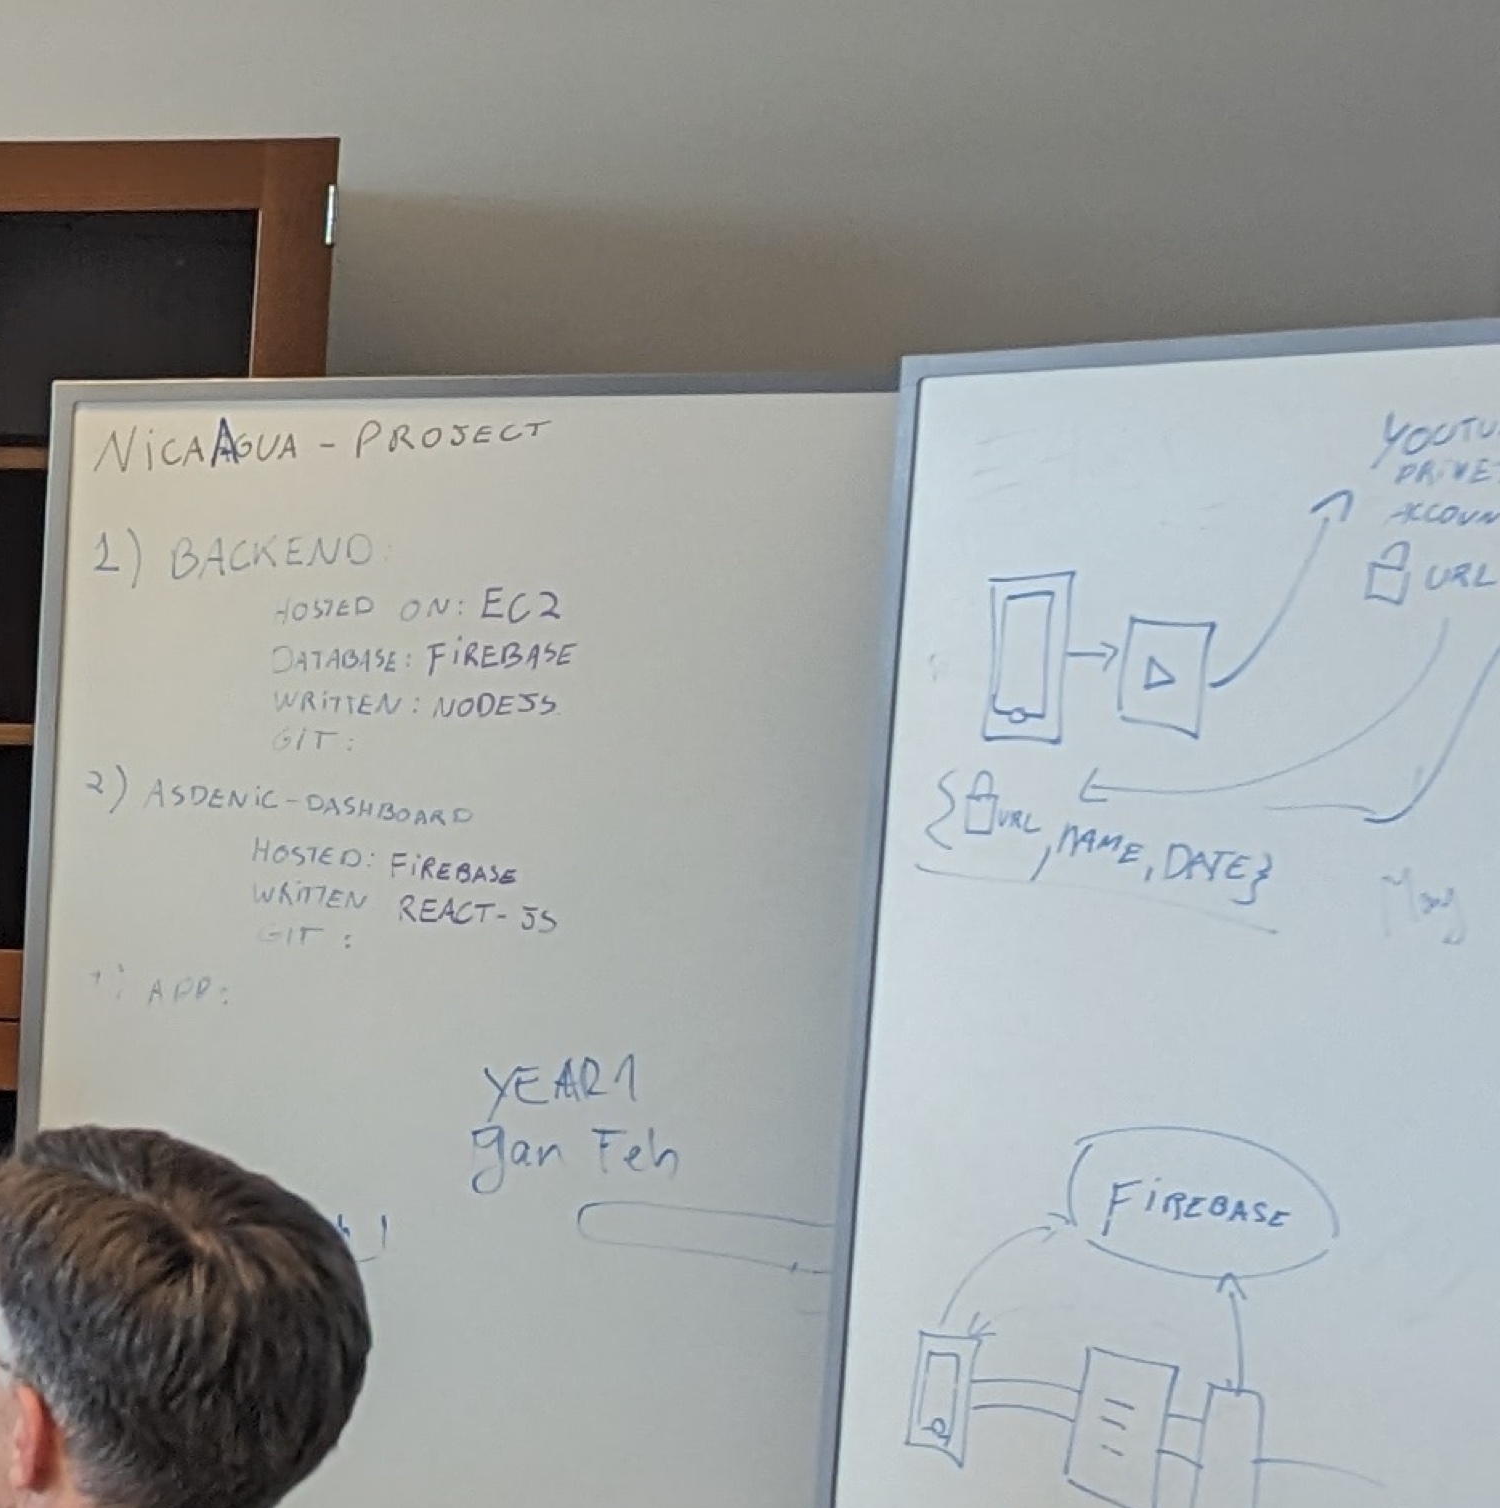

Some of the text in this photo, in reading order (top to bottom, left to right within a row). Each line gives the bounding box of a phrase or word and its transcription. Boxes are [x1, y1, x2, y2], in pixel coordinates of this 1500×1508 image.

[355, 418, 552, 460] PROJECT
[1425, 561, 1496, 591] URL
[274, 595, 375, 625] HOSTED
[480, 586, 561, 625] EC2
[997, 807, 1042, 835] URL
